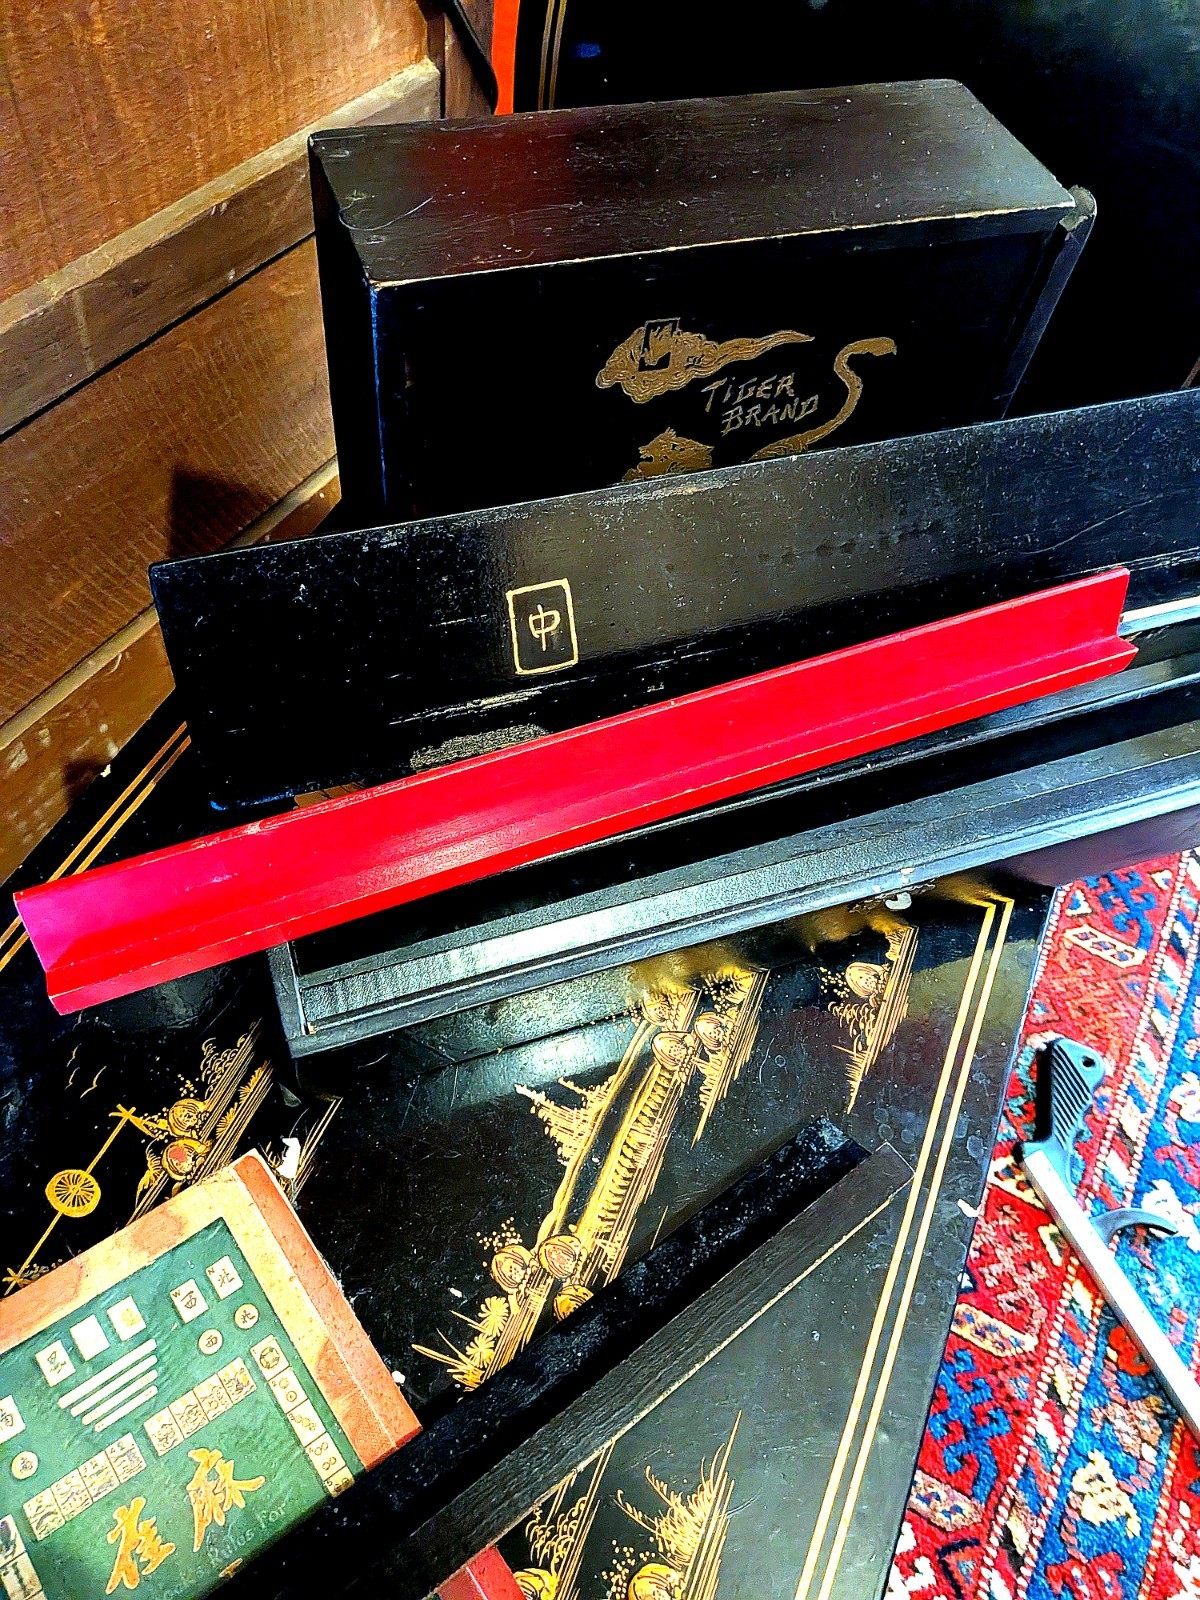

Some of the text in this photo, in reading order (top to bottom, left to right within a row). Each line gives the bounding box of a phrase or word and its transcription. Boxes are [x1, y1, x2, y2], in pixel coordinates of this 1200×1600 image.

[721, 394, 819, 437] BRAND
[528, 604, 561, 651] 中
[217, 1268, 235, 1288] 北
[180, 1290, 198, 1310] 西
[241, 1309, 256, 1325] 北
[205, 1334, 219, 1348] 西
